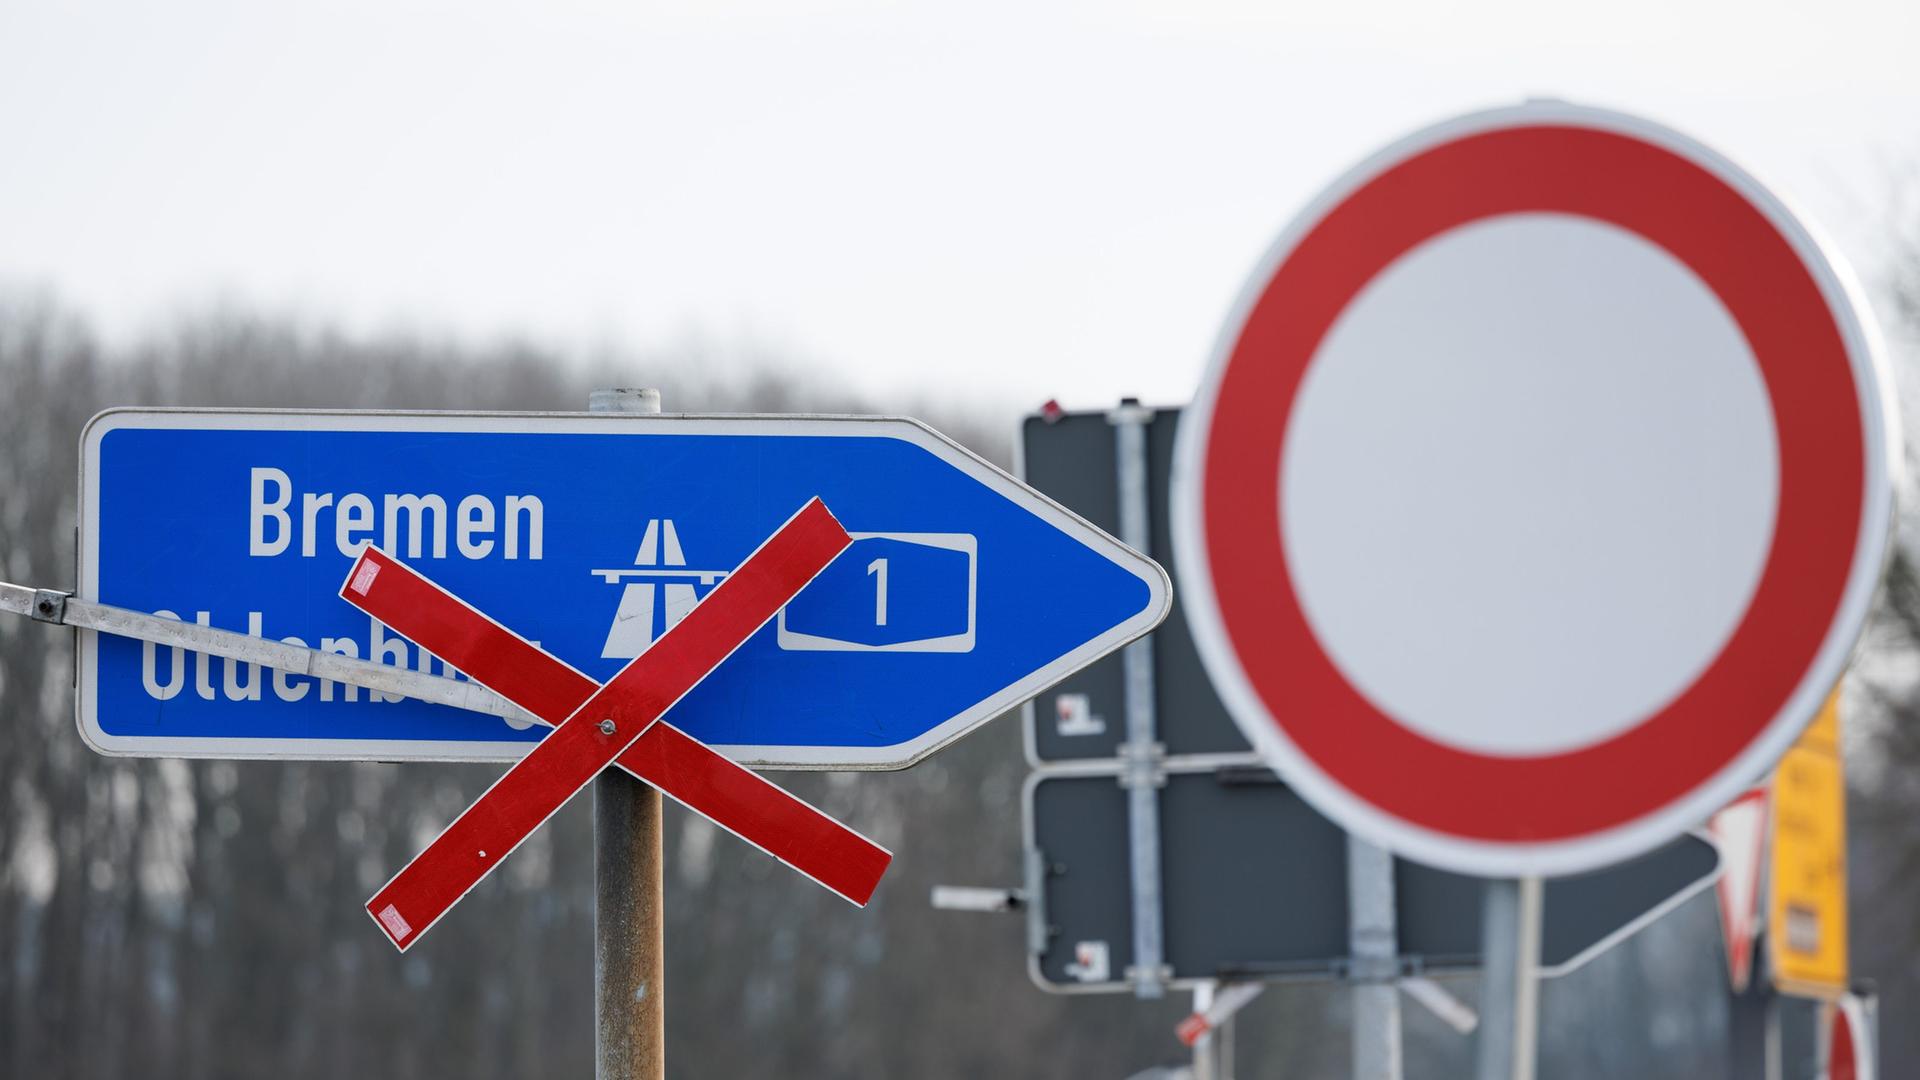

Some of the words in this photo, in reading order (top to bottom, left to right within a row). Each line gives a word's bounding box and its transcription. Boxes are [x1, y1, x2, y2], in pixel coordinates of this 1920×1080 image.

[249, 467, 544, 561] Bremen
[867, 558, 888, 626] 1
[142, 609, 541, 731] Oldenb
